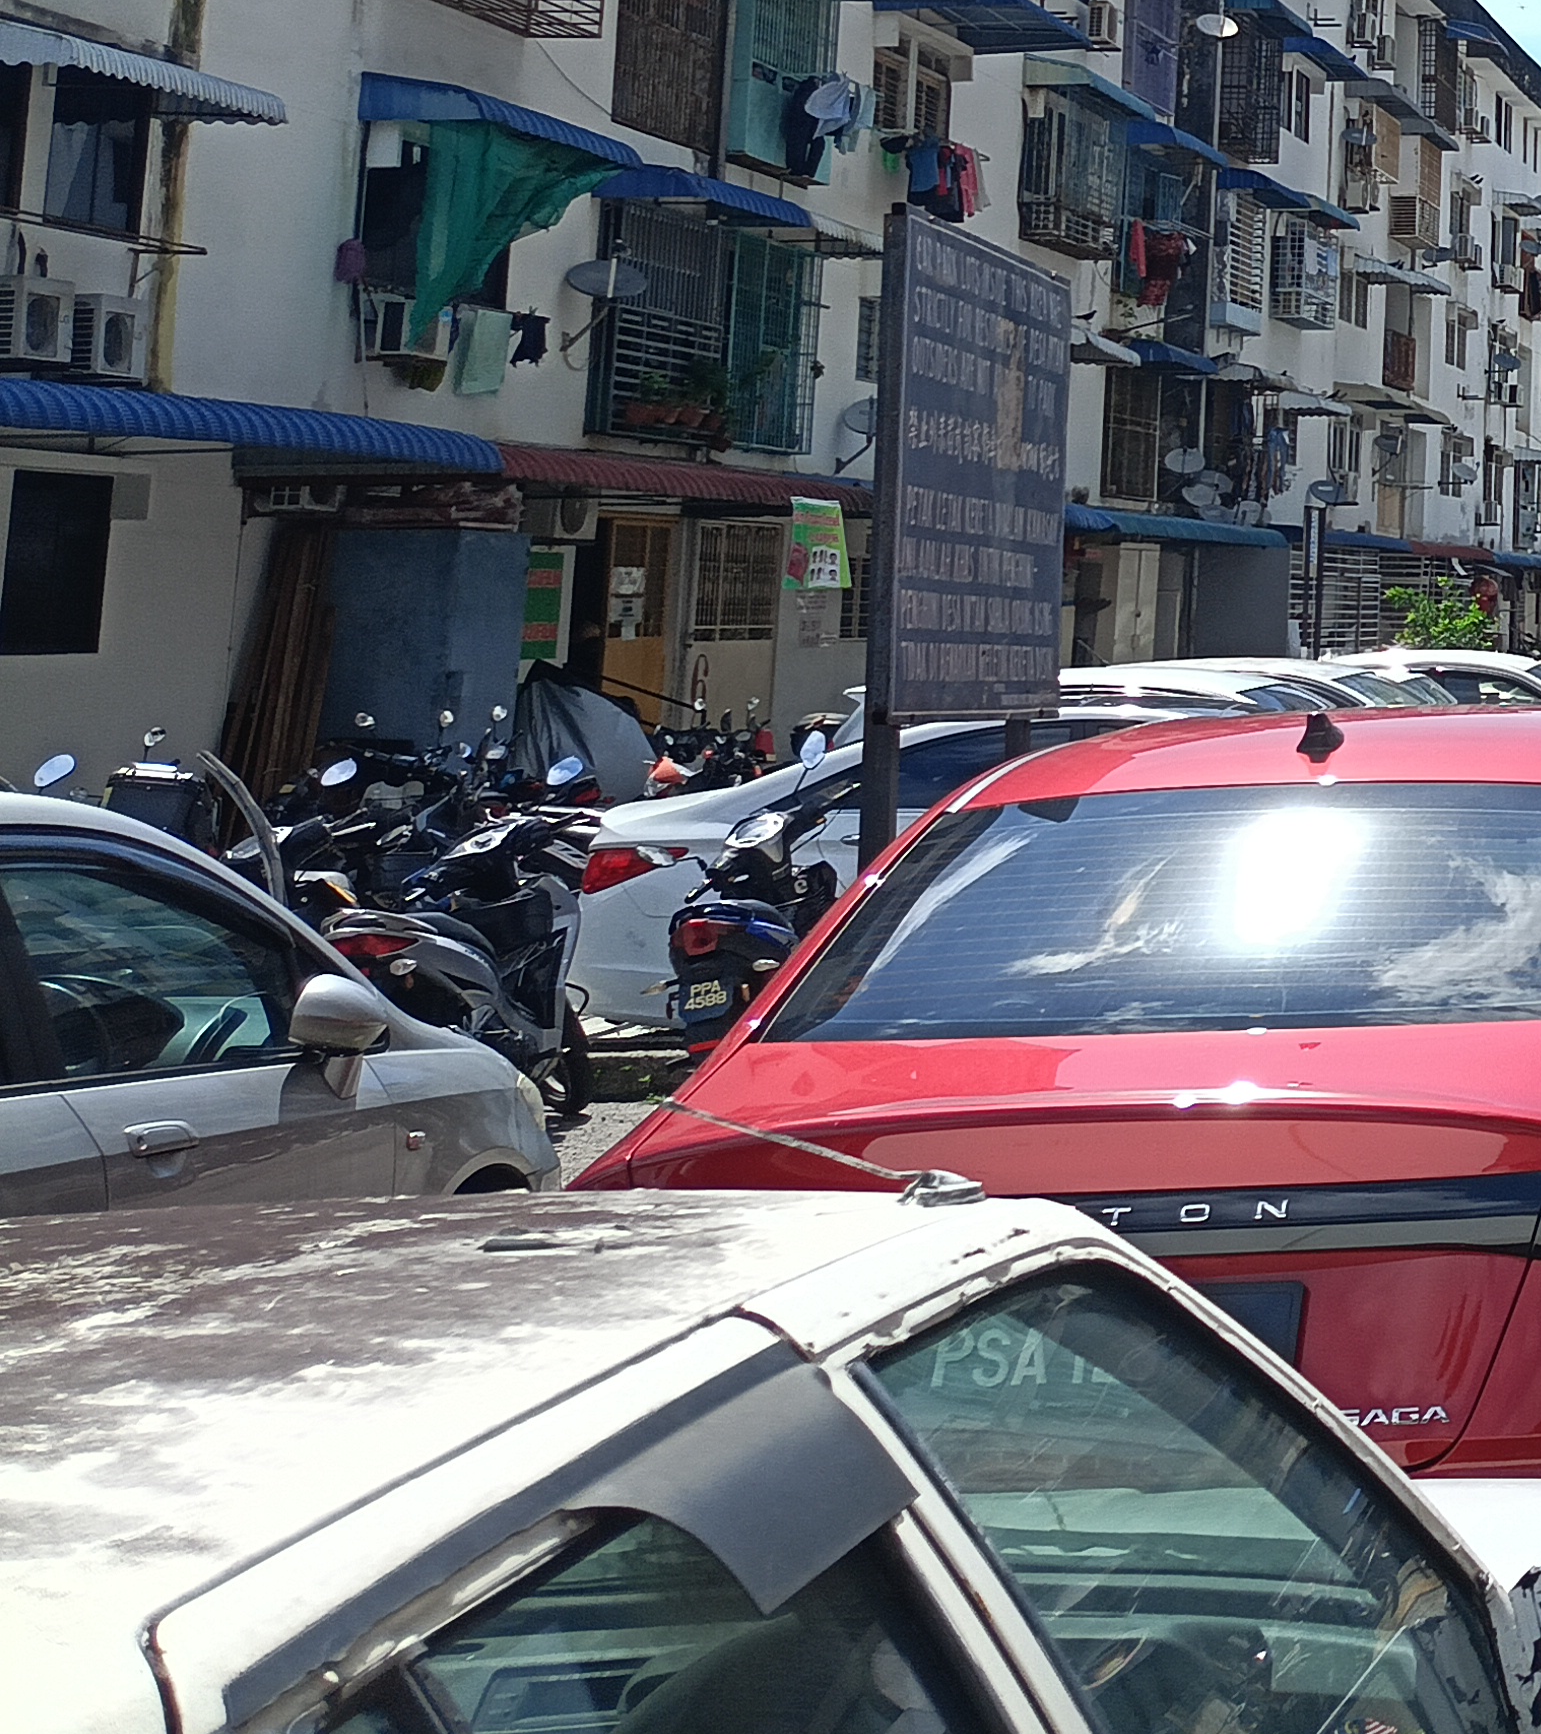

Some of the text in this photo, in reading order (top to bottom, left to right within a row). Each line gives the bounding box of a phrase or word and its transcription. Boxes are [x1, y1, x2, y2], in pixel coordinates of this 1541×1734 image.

[690, 979, 721, 997] PPA
[684, 990, 727, 1010] 4588
[930, 1327, 1047, 1388] PSA
[1341, 1404, 1450, 1427] SAGA
